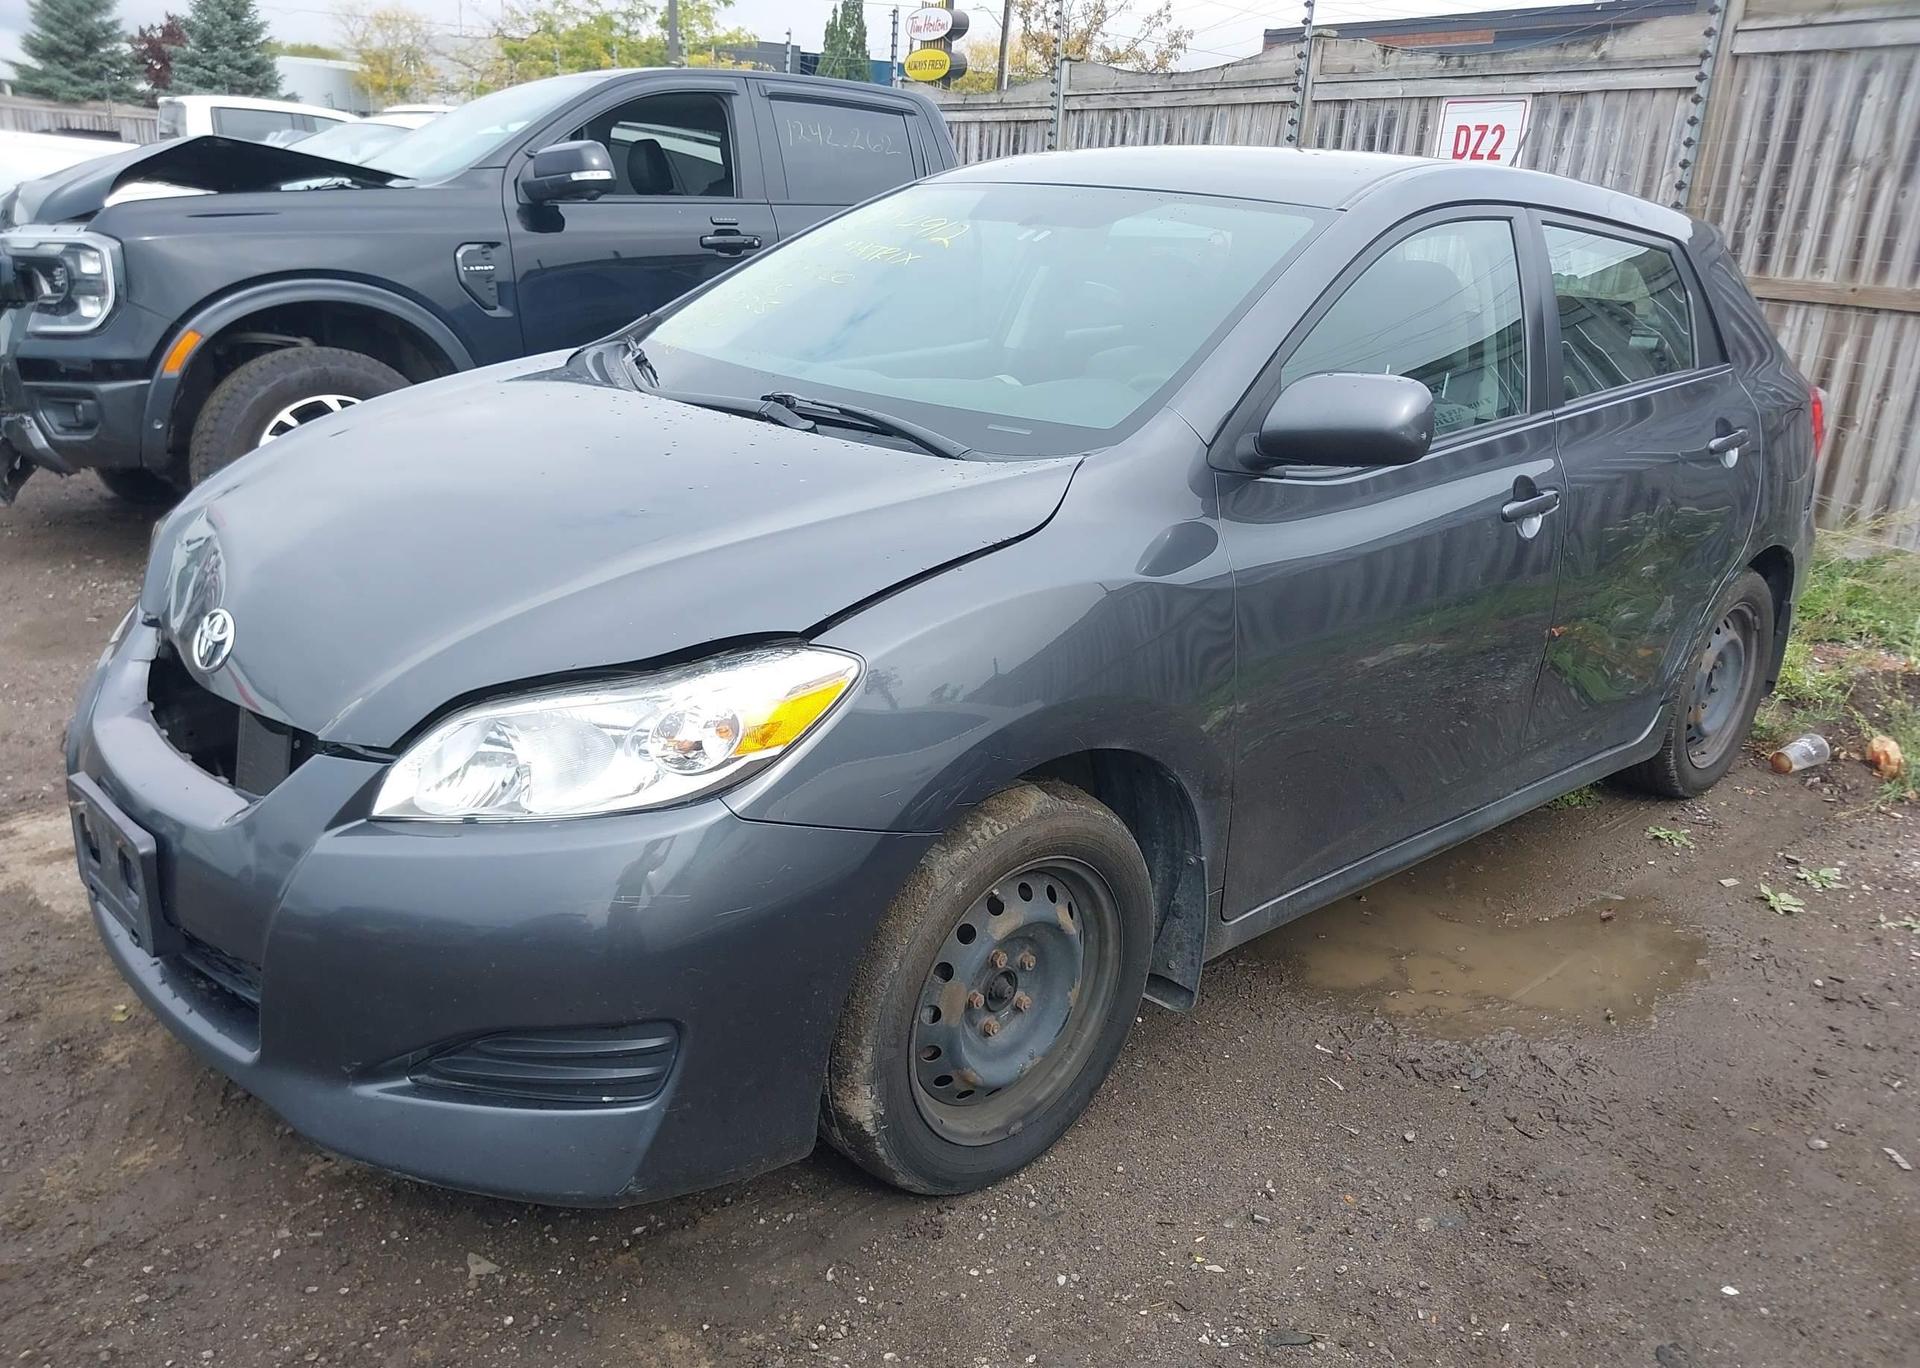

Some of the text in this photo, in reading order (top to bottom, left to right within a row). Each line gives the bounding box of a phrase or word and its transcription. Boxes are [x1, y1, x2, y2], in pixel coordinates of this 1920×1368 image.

[909, 16, 923, 34] Tim
[928, 59, 947, 71] FRESH
[1452, 124, 1506, 160] DZ2
